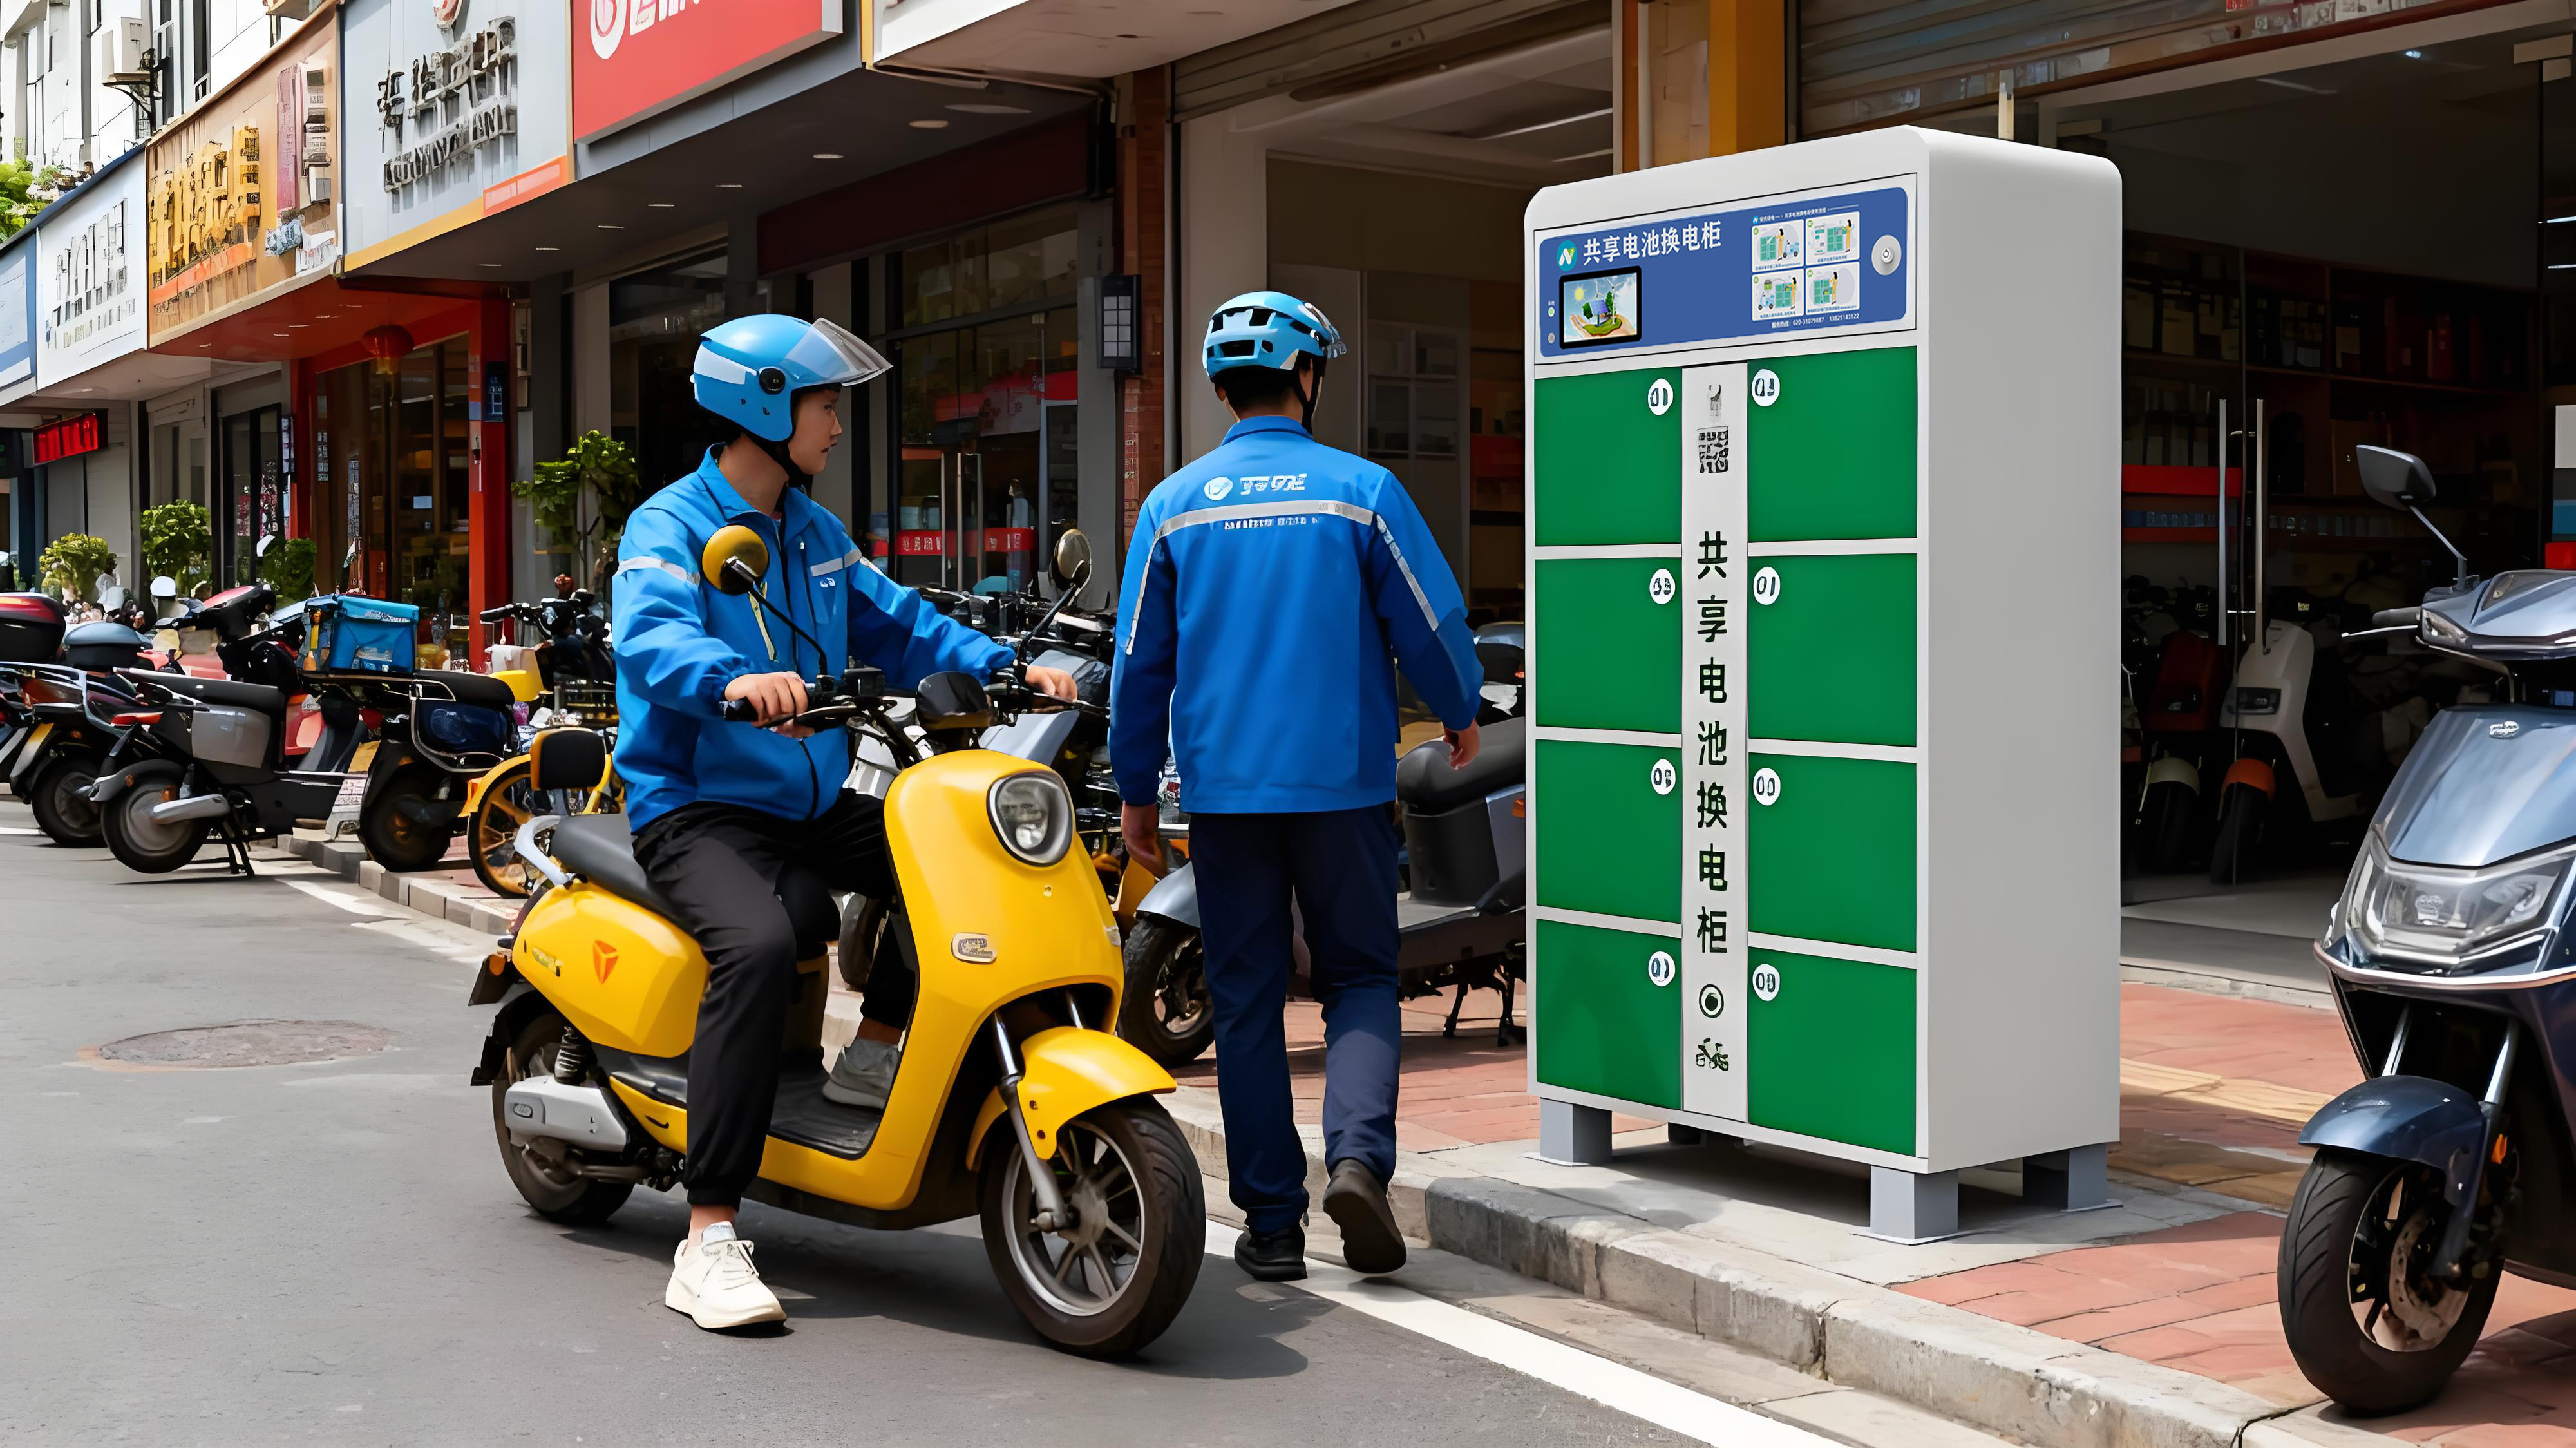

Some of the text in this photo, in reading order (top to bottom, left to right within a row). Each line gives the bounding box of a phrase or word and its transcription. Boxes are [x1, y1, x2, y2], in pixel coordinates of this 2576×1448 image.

[1583, 220, 1721, 266] 共享电池换电柜
[1696, 531, 1728, 953] 共享电池换电柜
